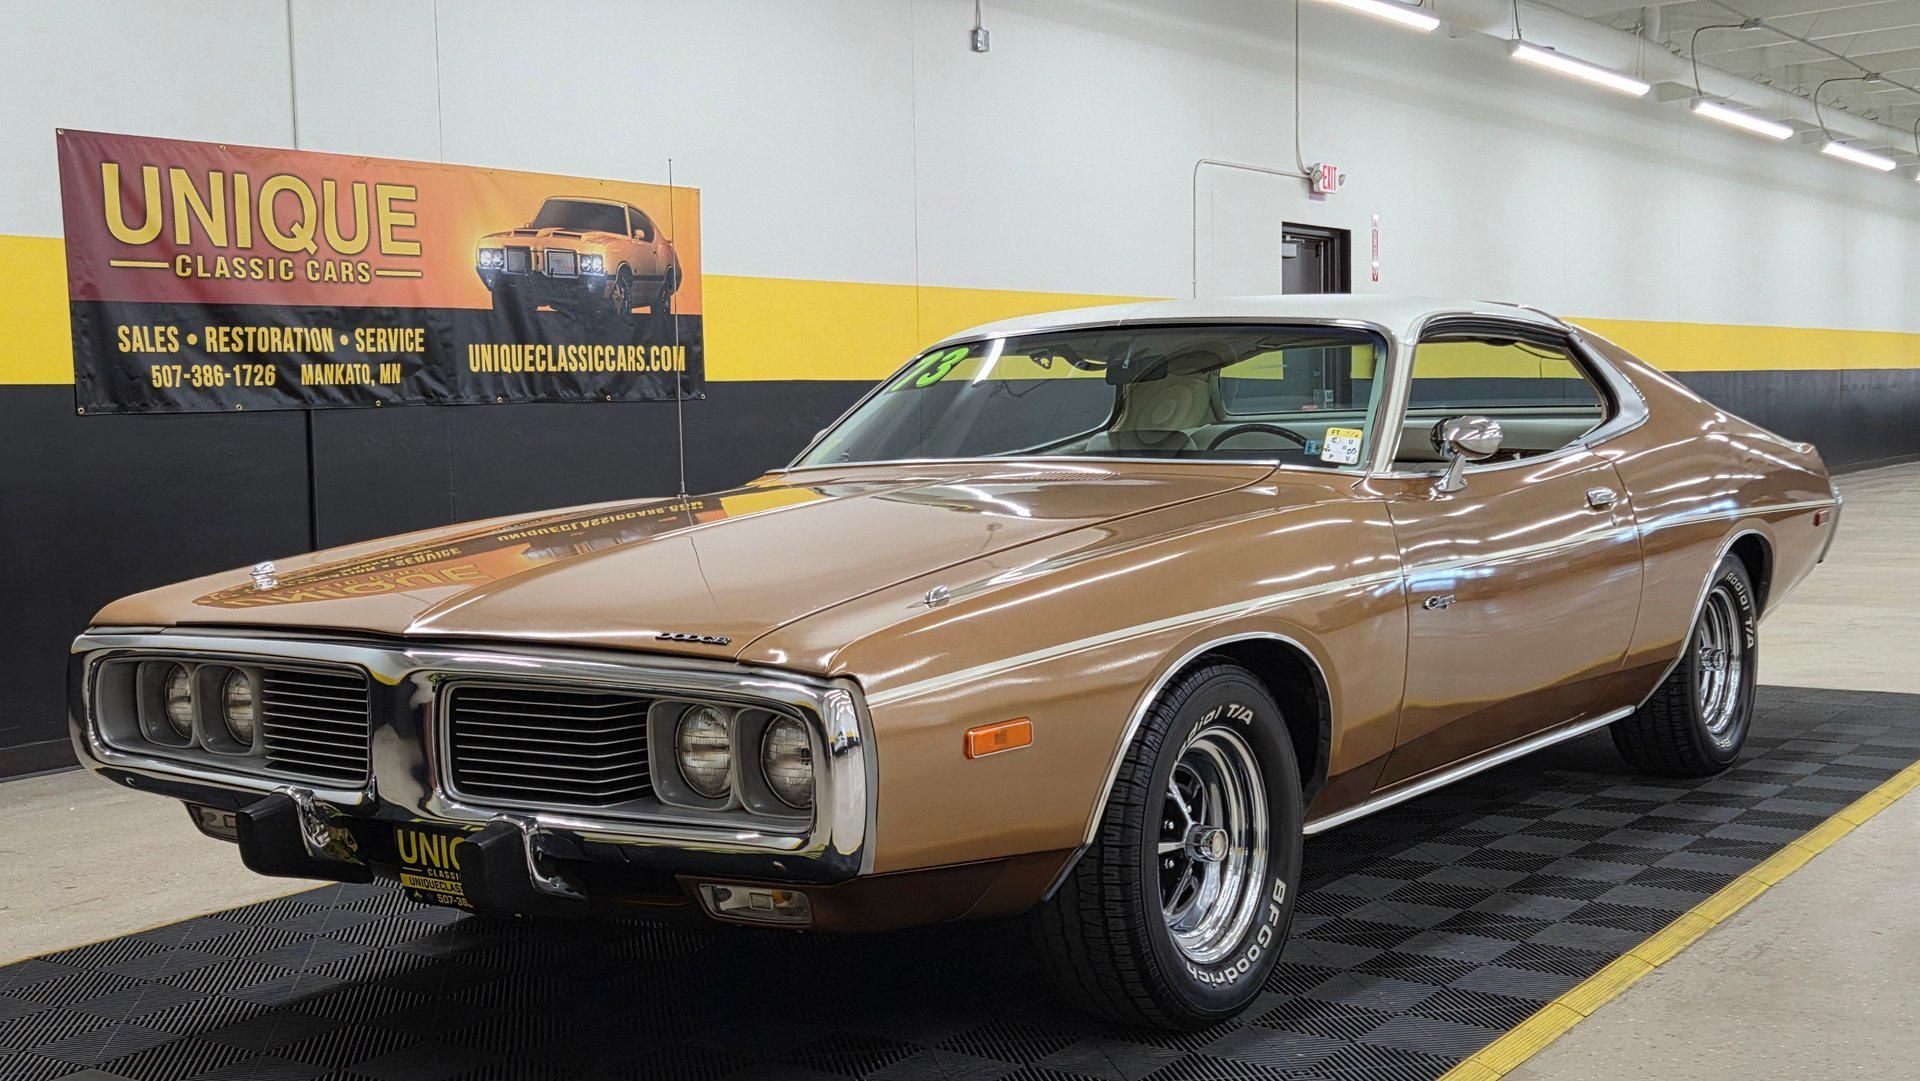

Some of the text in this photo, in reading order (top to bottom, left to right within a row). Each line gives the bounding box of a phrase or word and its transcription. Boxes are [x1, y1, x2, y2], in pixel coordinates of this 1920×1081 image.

[1322, 165, 1337, 191] EXIT
[101, 162, 422, 256] UNIQUE
[175, 254, 371, 283] CLASSIC CARS
[117, 325, 425, 353] SALES RESTORATION SERVICE
[468, 344, 686, 374] UNIQUECLASSICCARS.COM
[151, 364, 276, 388] 507-386-1726
[301, 363, 401, 387] MANKATO, MN
[1744, 616, 1755, 649] T/A
[1226, 703, 1254, 726] T/A
[427, 868, 460, 881] CLASSI
[1186, 878, 1287, 989] BFGoodrich
